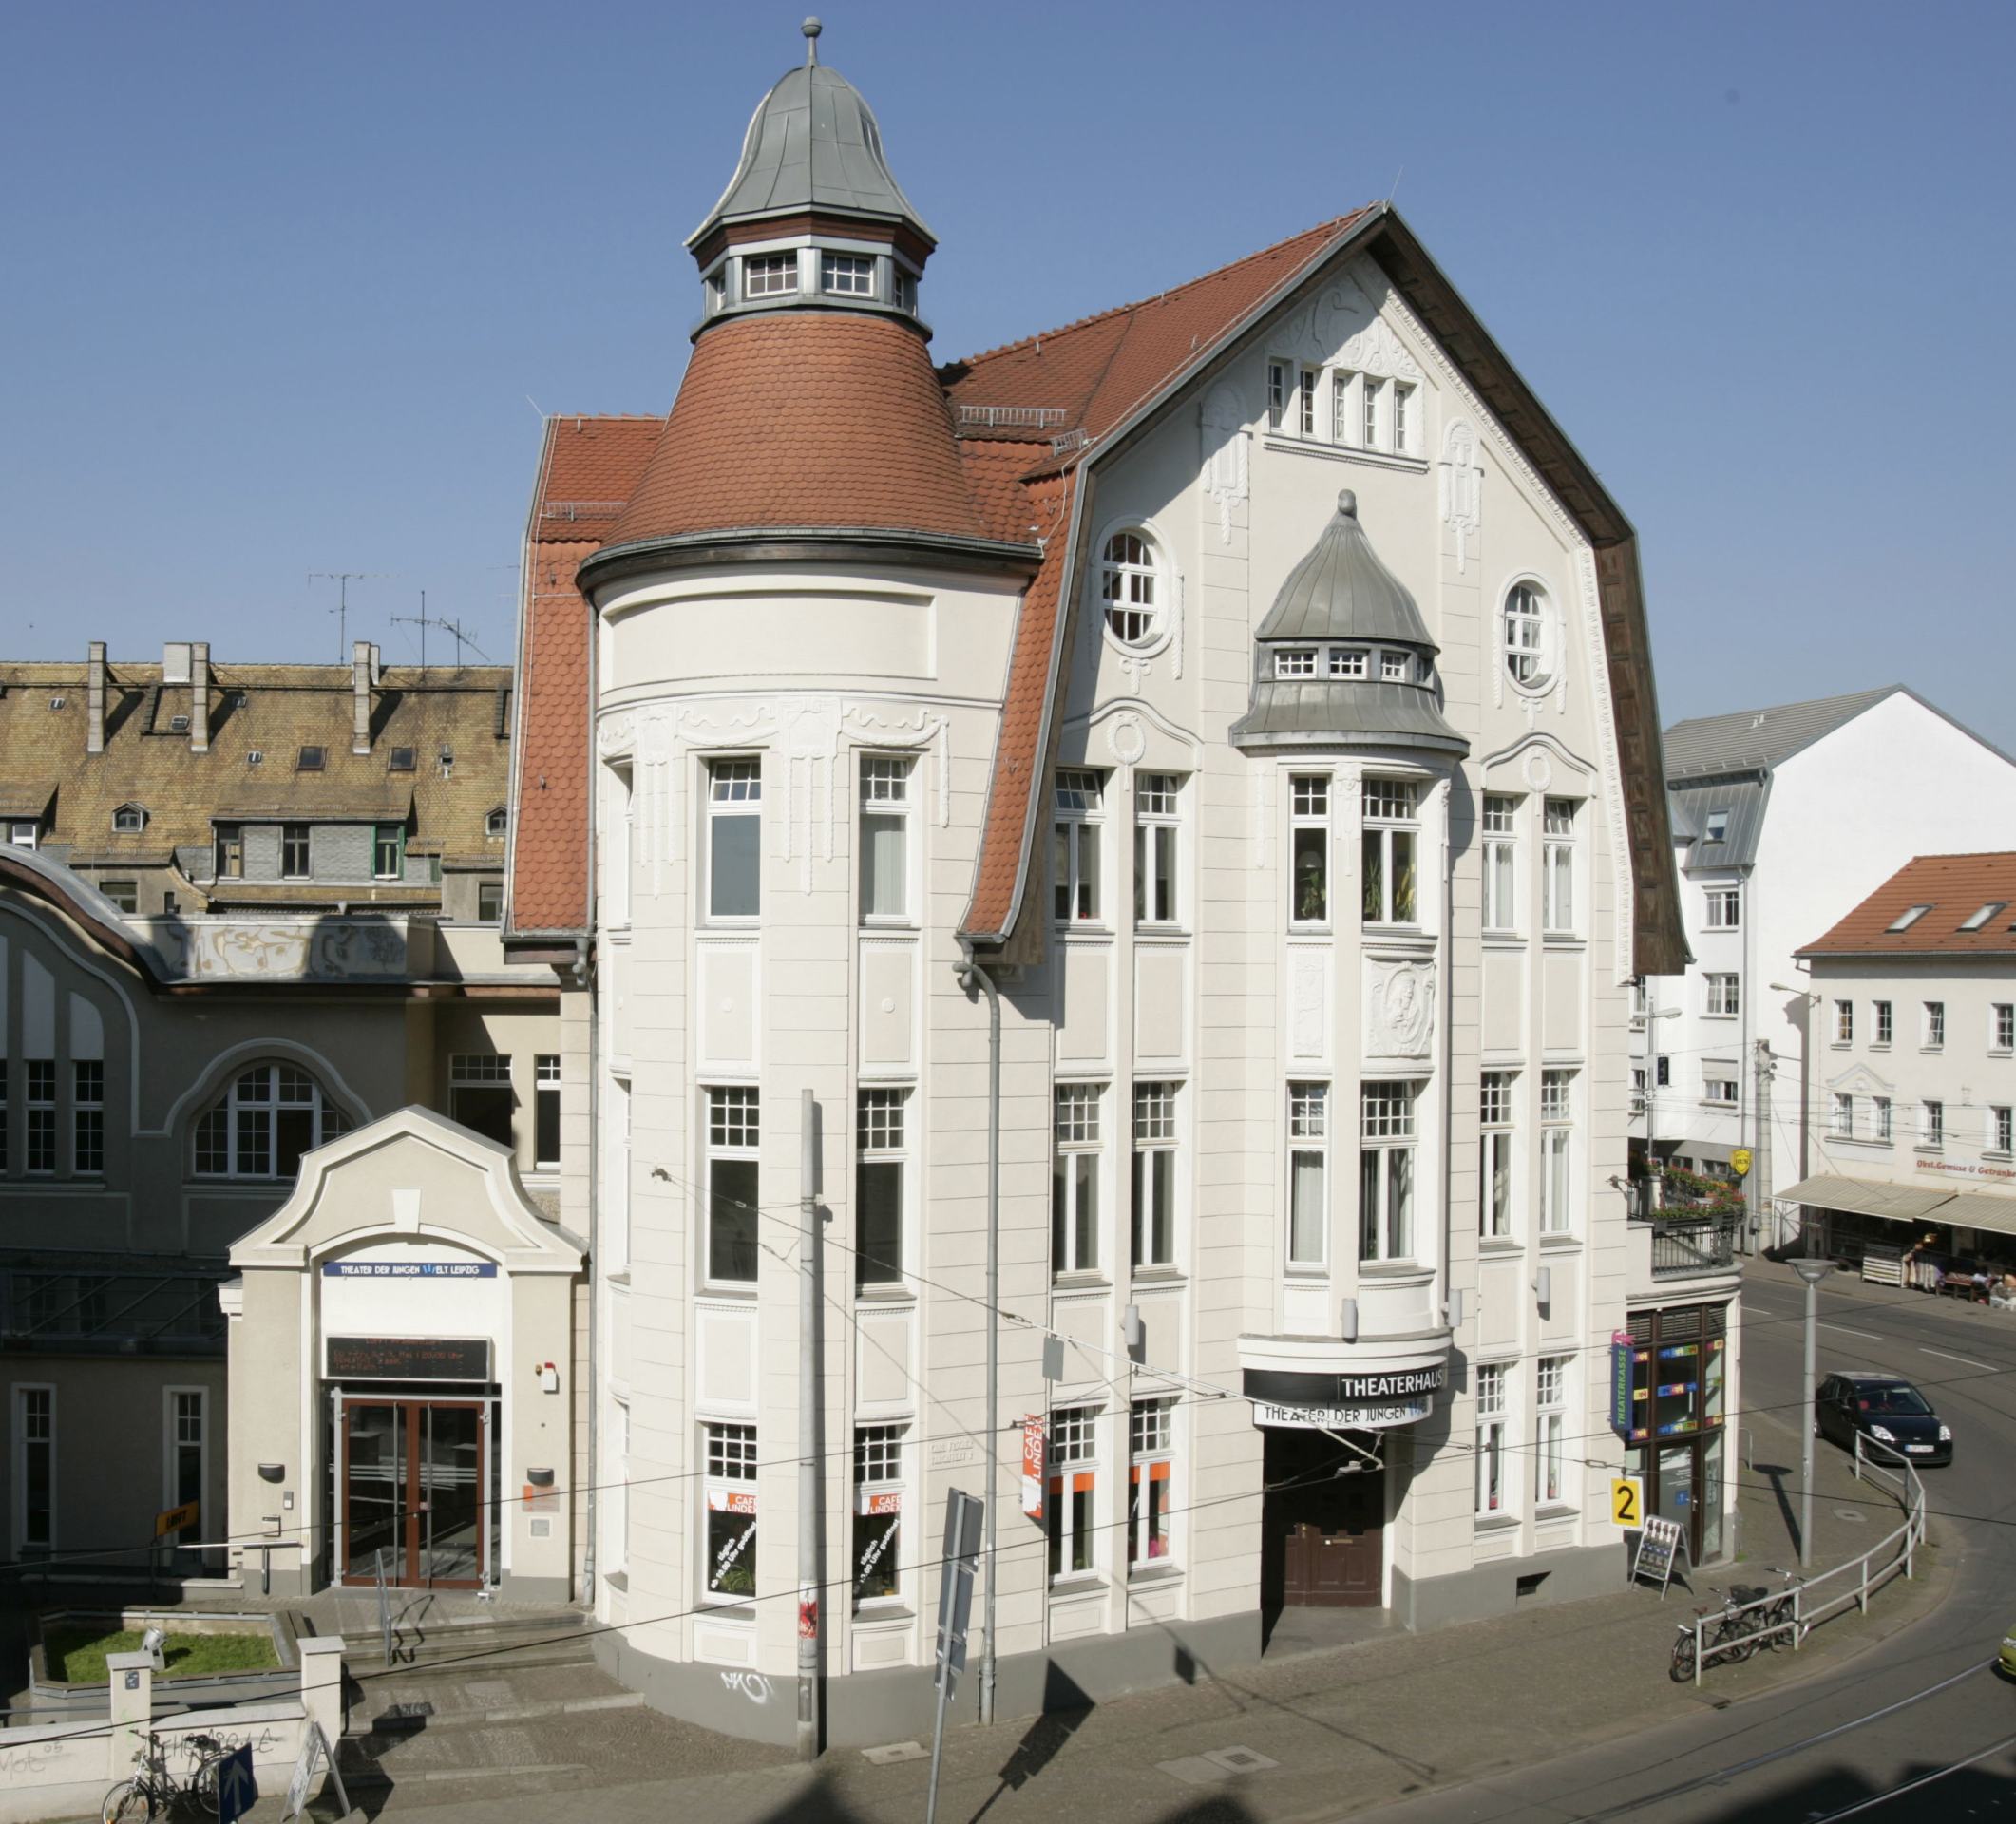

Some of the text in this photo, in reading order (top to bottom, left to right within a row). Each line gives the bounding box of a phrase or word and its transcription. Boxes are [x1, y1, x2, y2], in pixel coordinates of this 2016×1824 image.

[340, 1265, 372, 1274] THEATER
[375, 1265, 390, 1274] DER
[392, 1265, 420, 1274] JUNGEN
[450, 1265, 480, 1274] LEIPZIG
[1341, 1369, 1443, 1396] THEATERHAUS
[1617, 1349, 1626, 1425] THEATERKASSE
[1334, 1409, 1360, 1423] DER
[1366, 1406, 1406, 1422] JUNGEN
[1617, 1485, 1635, 1520] 2
[728, 1548, 739, 1562] Uhr
[869, 1548, 882, 1564] Uhr
